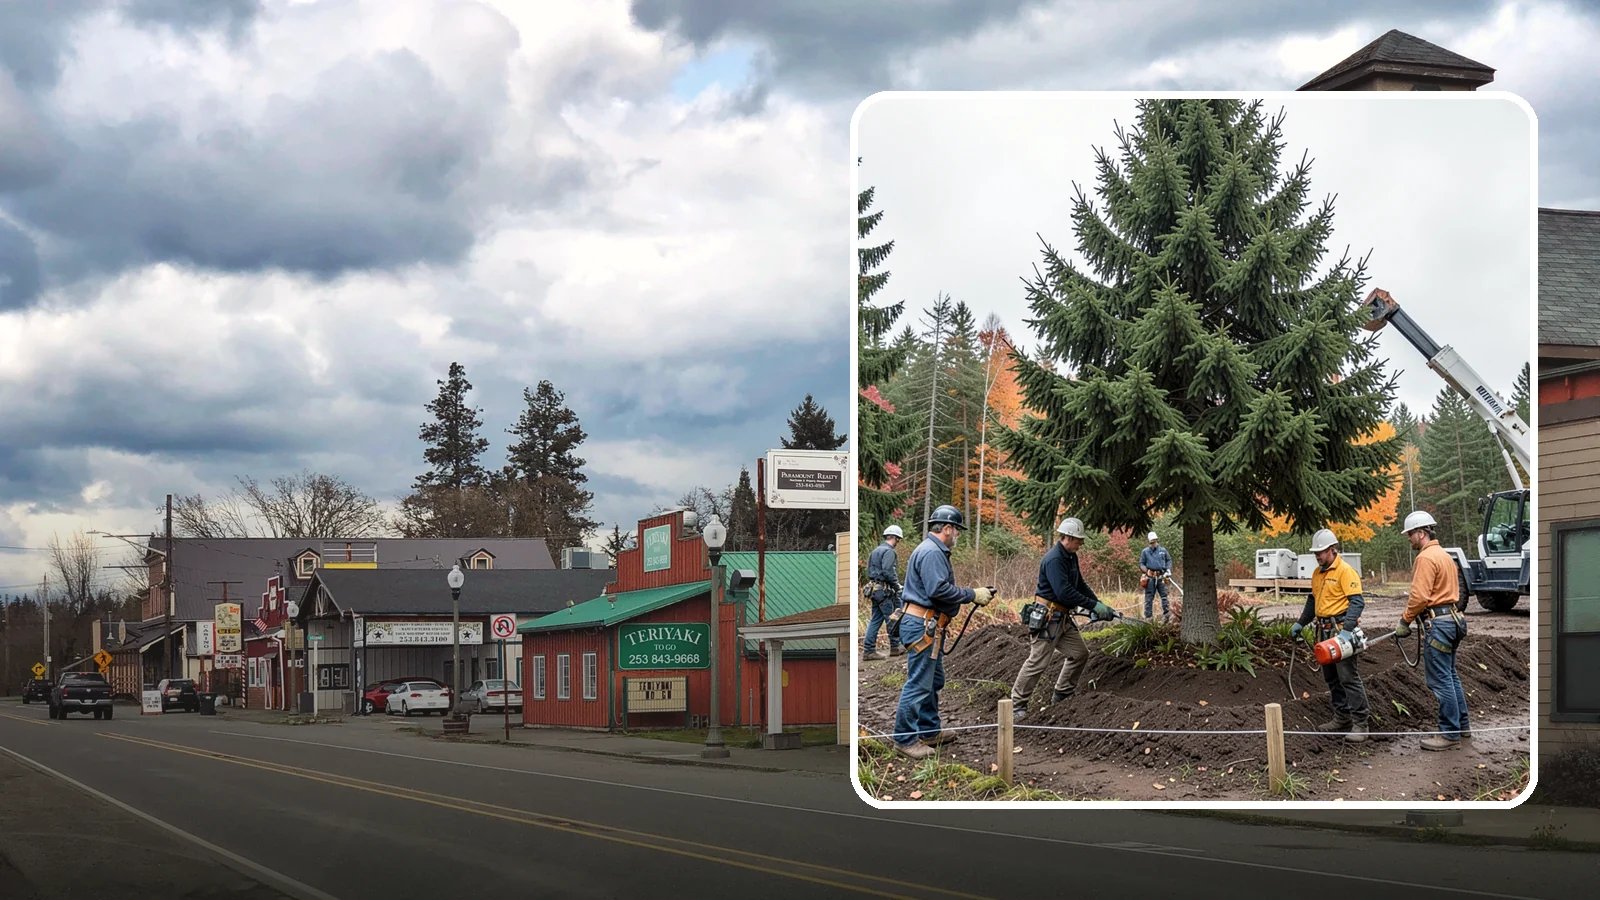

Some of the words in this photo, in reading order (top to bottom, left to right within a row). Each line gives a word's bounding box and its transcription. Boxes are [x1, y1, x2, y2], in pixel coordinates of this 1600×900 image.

[625, 628, 702, 646] TERIYAKI
[629, 655, 649, 665] 253
[651, 654, 700, 664] 843-9668
